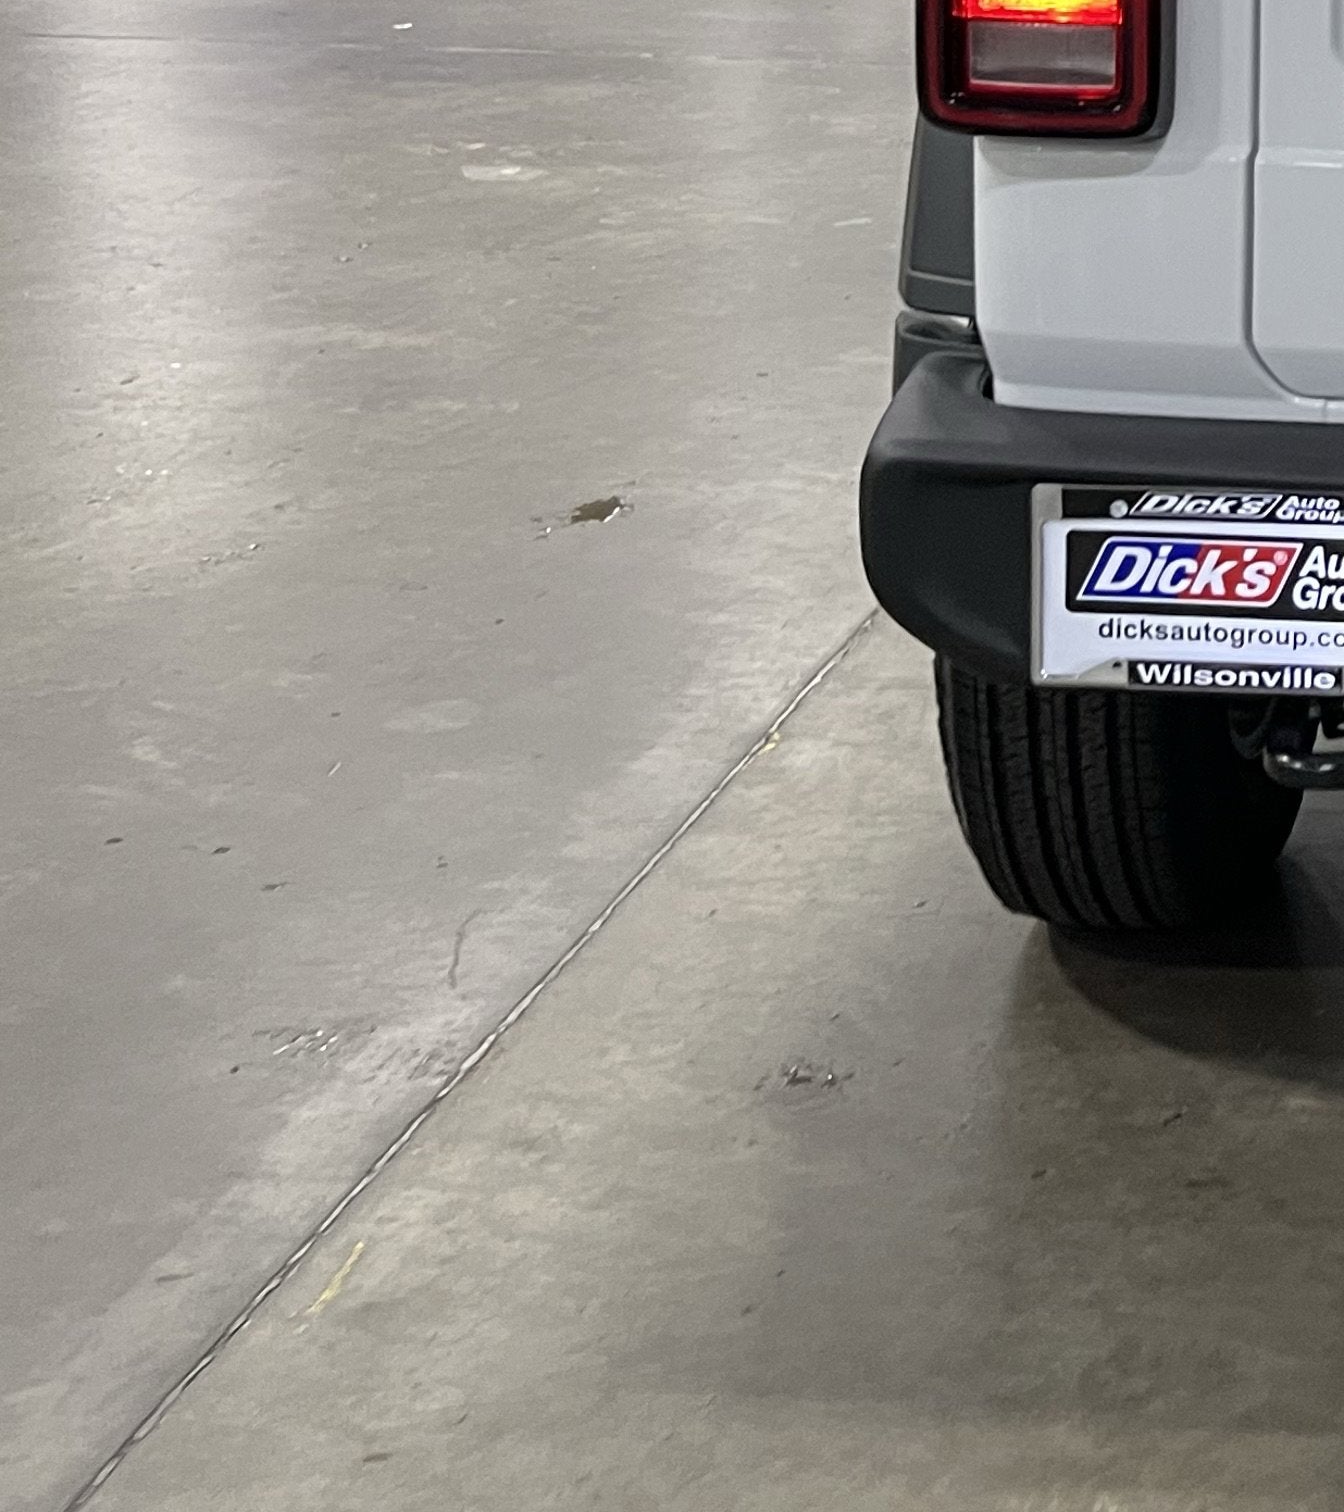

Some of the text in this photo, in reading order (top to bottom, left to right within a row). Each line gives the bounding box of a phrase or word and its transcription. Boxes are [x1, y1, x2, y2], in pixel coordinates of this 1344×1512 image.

[1285, 496, 1341, 510] Auto
[1094, 544, 1280, 599] Dick's
[1136, 662, 1337, 689] Wilsonville
